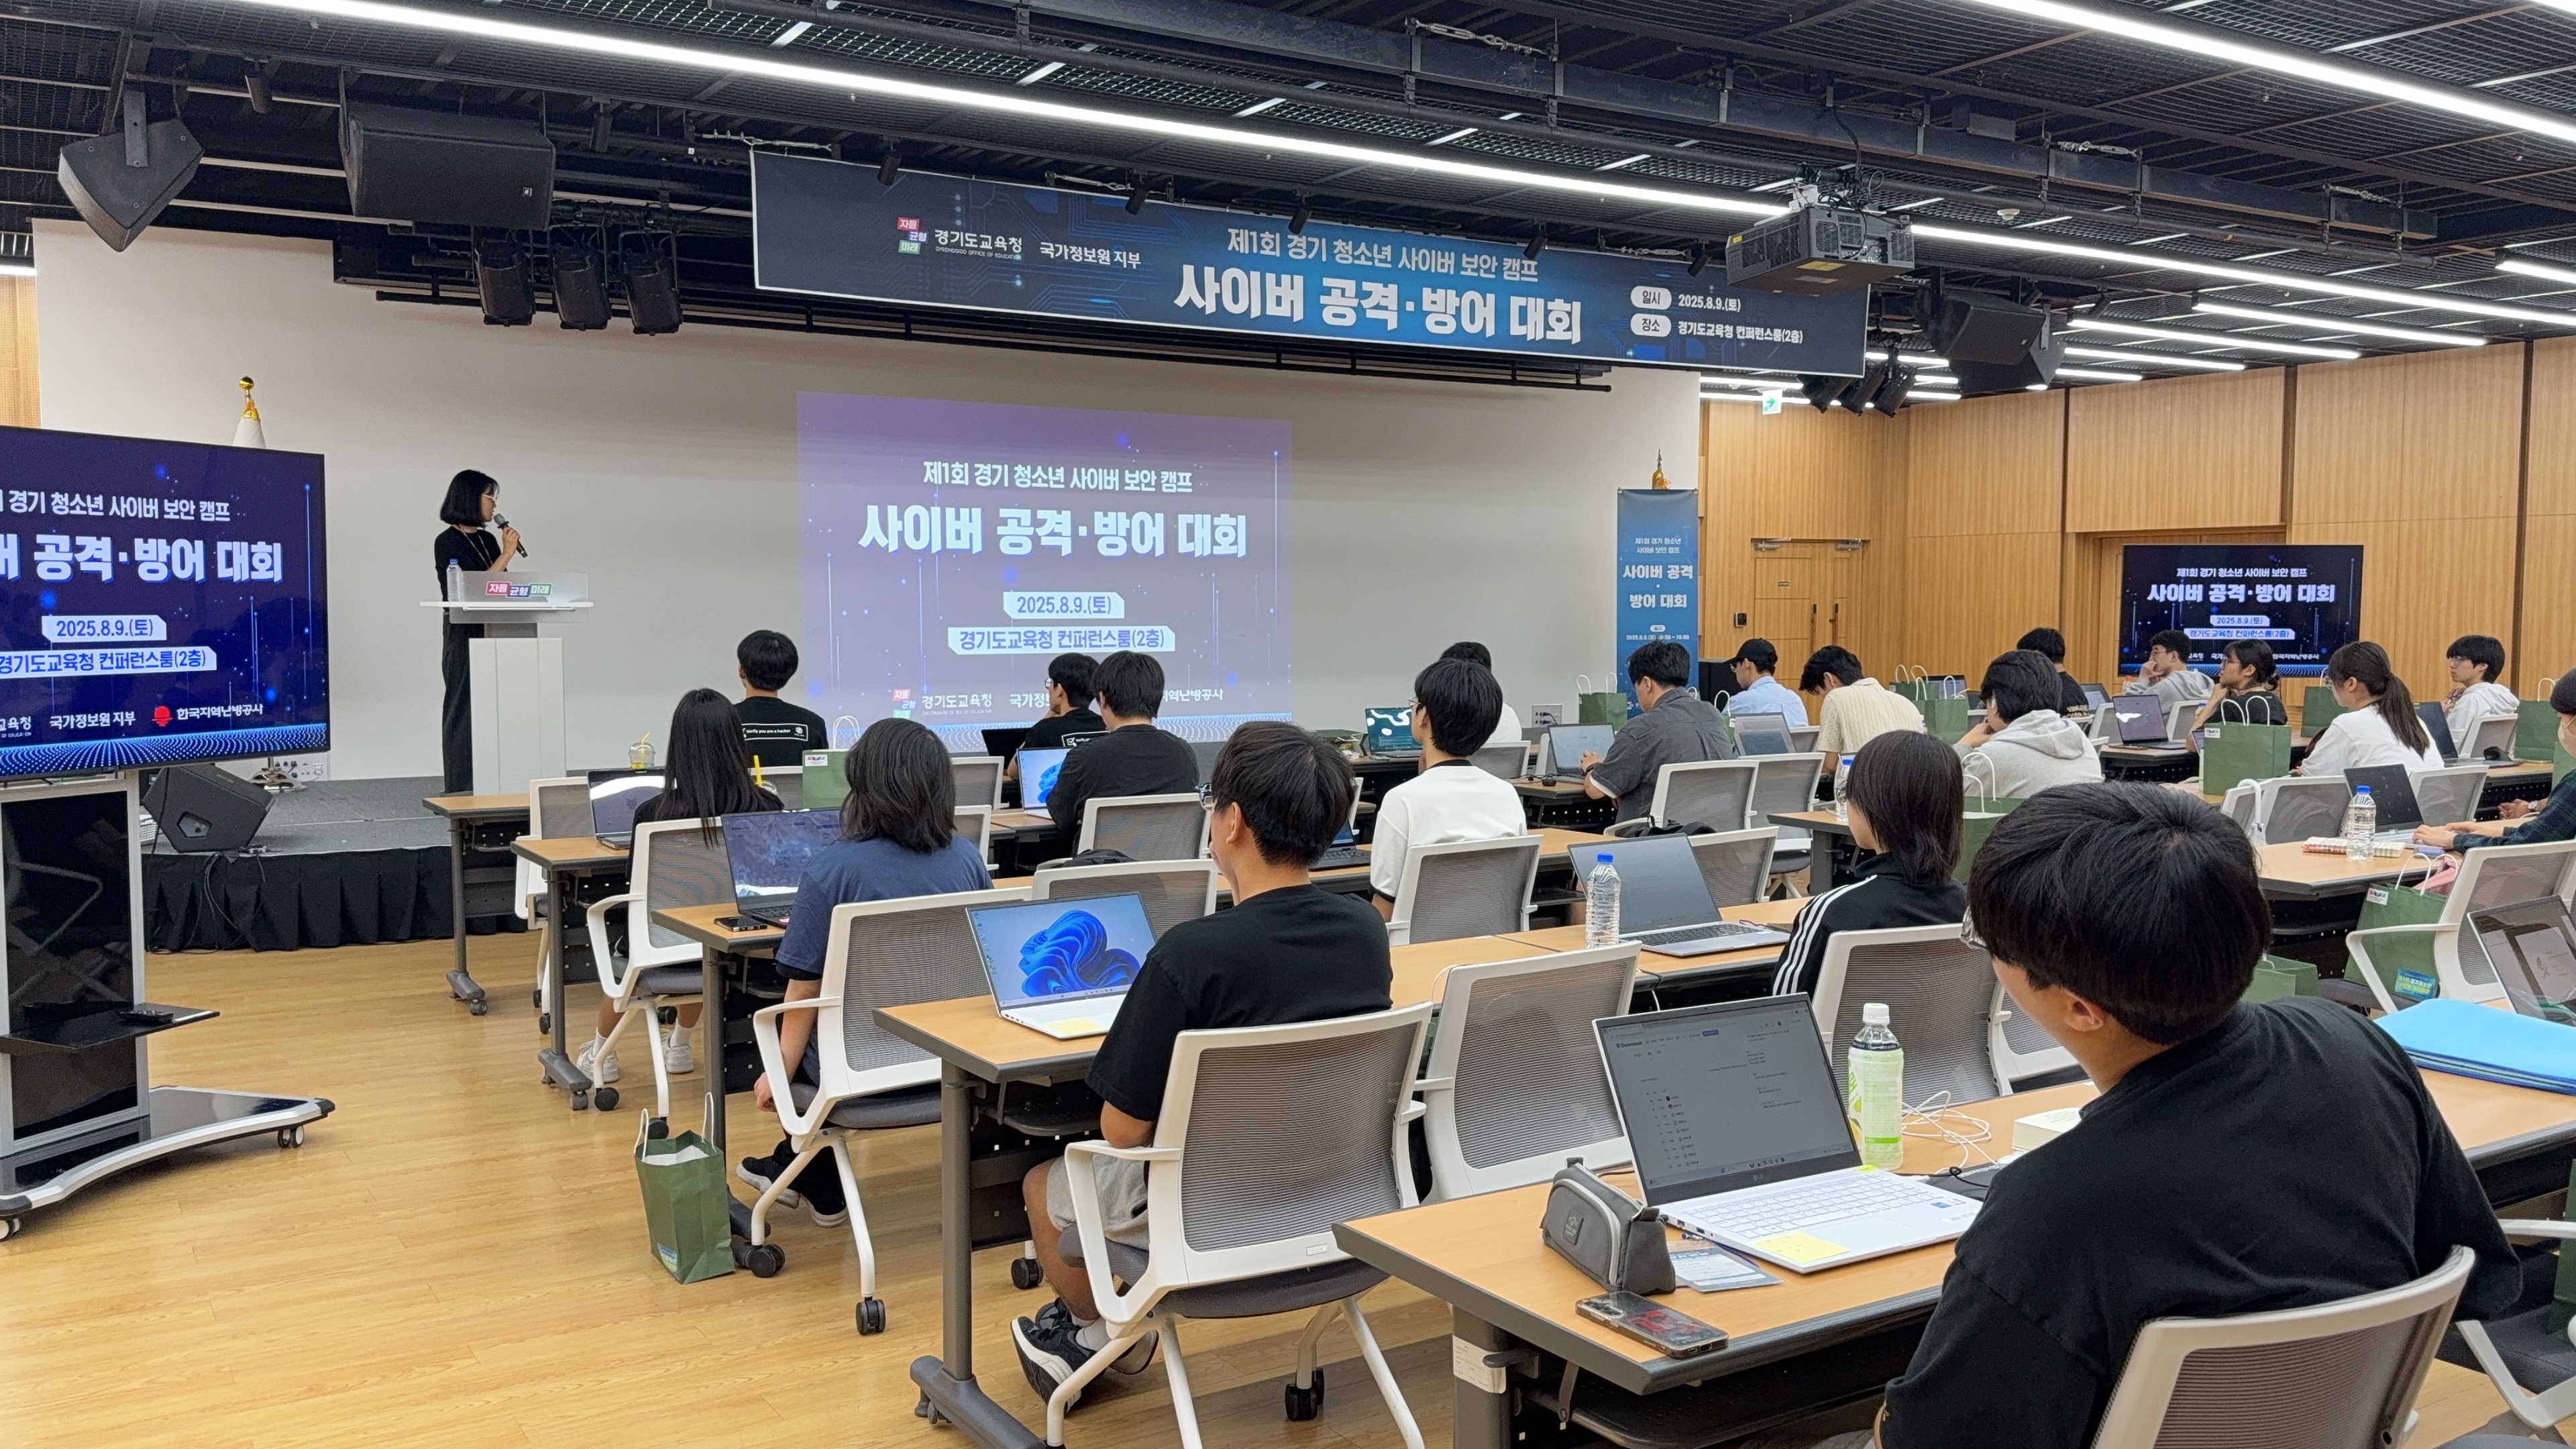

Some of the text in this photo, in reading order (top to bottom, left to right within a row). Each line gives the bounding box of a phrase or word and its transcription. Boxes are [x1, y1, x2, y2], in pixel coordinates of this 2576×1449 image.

[901, 242, 918, 252] 미래
[934, 229, 1022, 253] 경기도교육청
[968, 250, 986, 258] OFFICE
[1040, 242, 1141, 268] 국가정보원 지부
[1228, 228, 1538, 282] 제1회 경기 청소년 사이버 보안 캠프
[1173, 264, 1582, 345] 사이버 공격·방어 대회
[1642, 290, 1660, 305] 일시
[1678, 294, 1741, 313] 2025.8.9.(토)
[1642, 318, 1660, 332] 장소
[1678, 321, 1803, 343] 경기도교육청 컨퍼런스룸(2층)
[922, 460, 1193, 494] 제1회 경기 청소년 사이버 보안 캠프
[9, 490, 45, 515] 경기
[50, 492, 104, 517] 청소년
[109, 496, 160, 520] 사이버
[164, 499, 195, 521] 보안
[200, 500, 231, 522] 캠프
[858, 504, 1247, 558] 사이버 공격·방어 대회
[34, 534, 205, 583] 공격·방어
[217, 541, 283, 583] 대회
[1622, 565, 1694, 580] 사이버 공격
[2176, 568, 2307, 578] 제1회 경기 청소년 사이버 보안 캠프
[510, 586, 529, 596] 균형
[531, 584, 549, 594] 미래
[2147, 584, 2335, 603] 사이버 공격·방어 대회
[1016, 596, 1112, 616] 2025.8.9.(토)
[1629, 594, 1687, 608] 방어 대회
[56, 619, 154, 638] 2025.8.9.(토)
[2216, 616, 2263, 626] 2025.8.9.(토)
[959, 629, 1165, 651] 경기도교육청 컨퍼런스룸(2층)
[2189, 629, 2233, 638] 경기도교육청
[0, 651, 206, 676] 경기도교육청 컨퍼런스룸(2층)
[922, 693, 992, 709] 경기도교육청
[50, 715, 110, 729] 국가정보원
[113, 712, 136, 727] 지부
[176, 704, 264, 720] 한국지역난방공사
